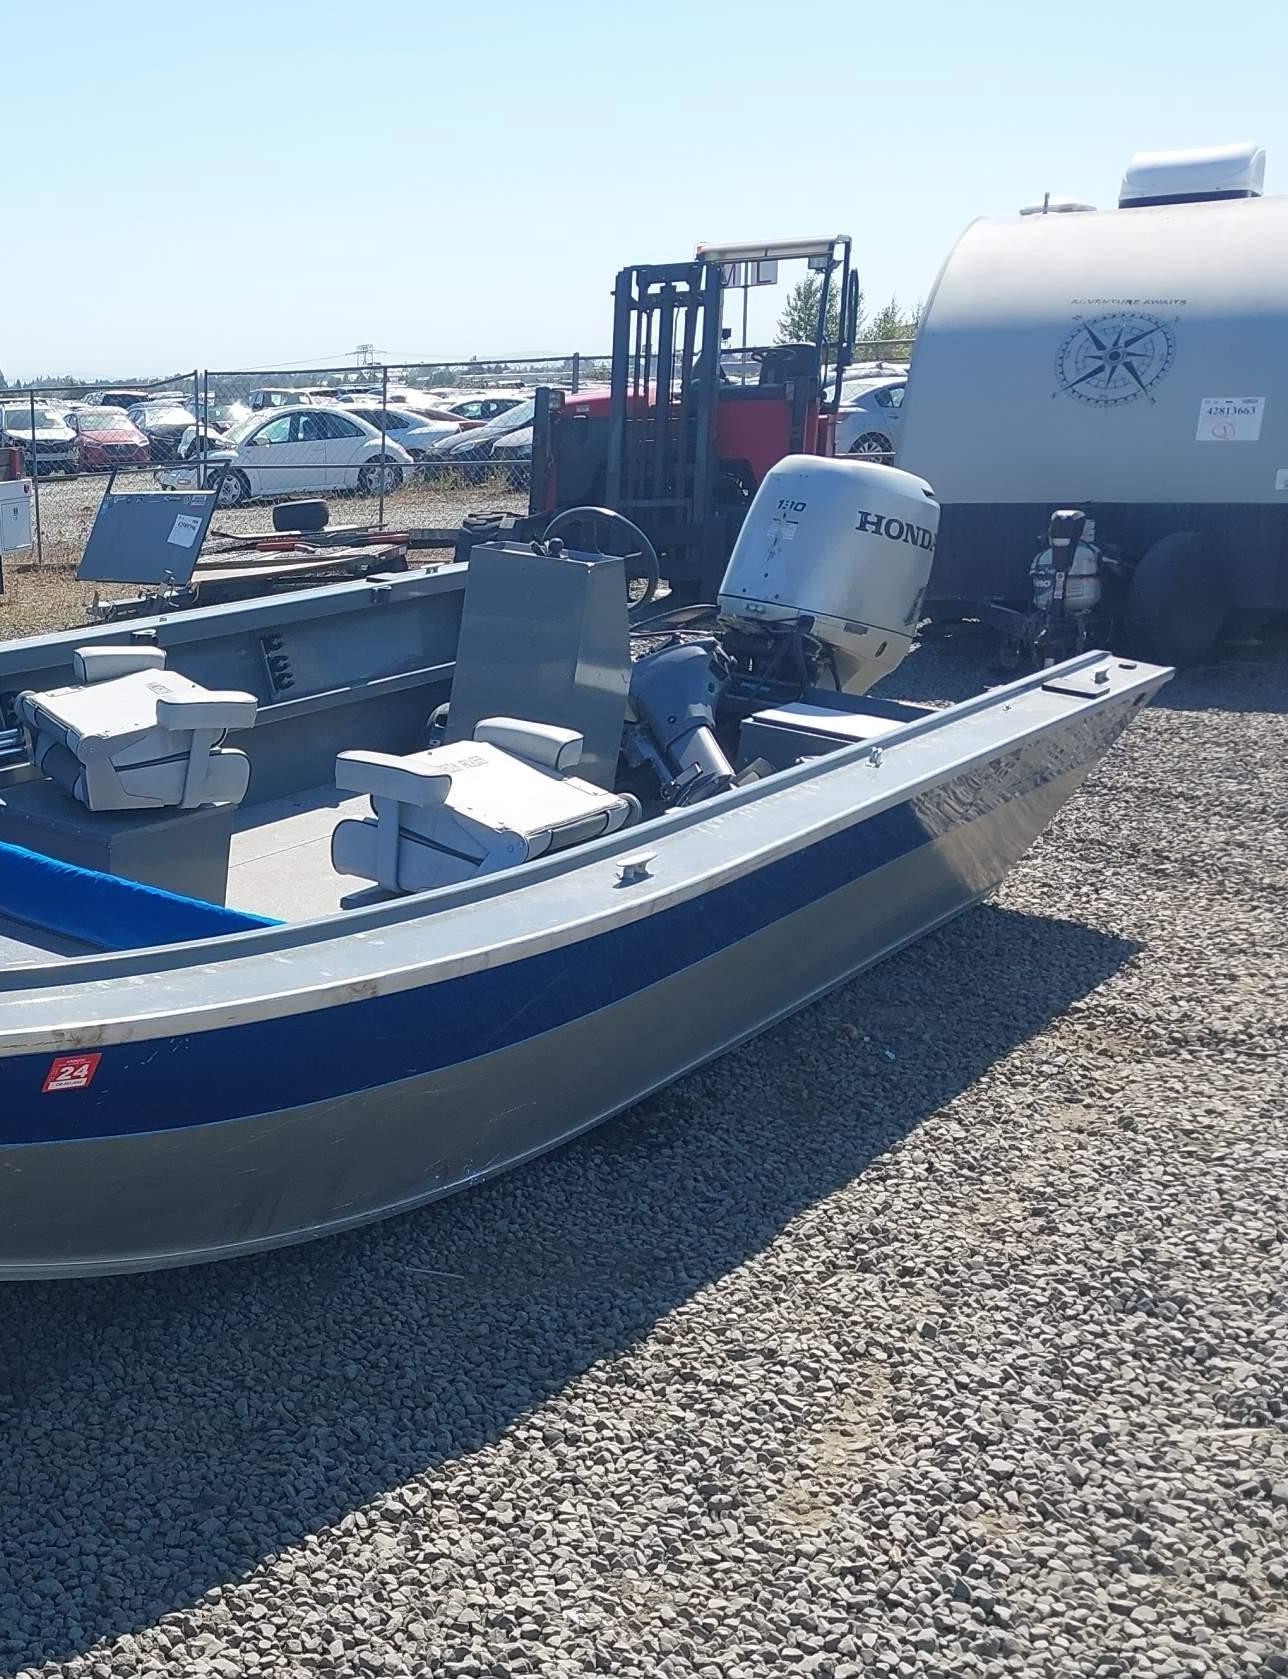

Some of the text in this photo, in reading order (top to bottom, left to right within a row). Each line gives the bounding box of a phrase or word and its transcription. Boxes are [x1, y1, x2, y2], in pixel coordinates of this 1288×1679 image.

[1070, 298, 1187, 306] ADVENTURE AWAITS
[1208, 406, 1257, 416] 42813663
[56, 1064, 89, 1081] 24
